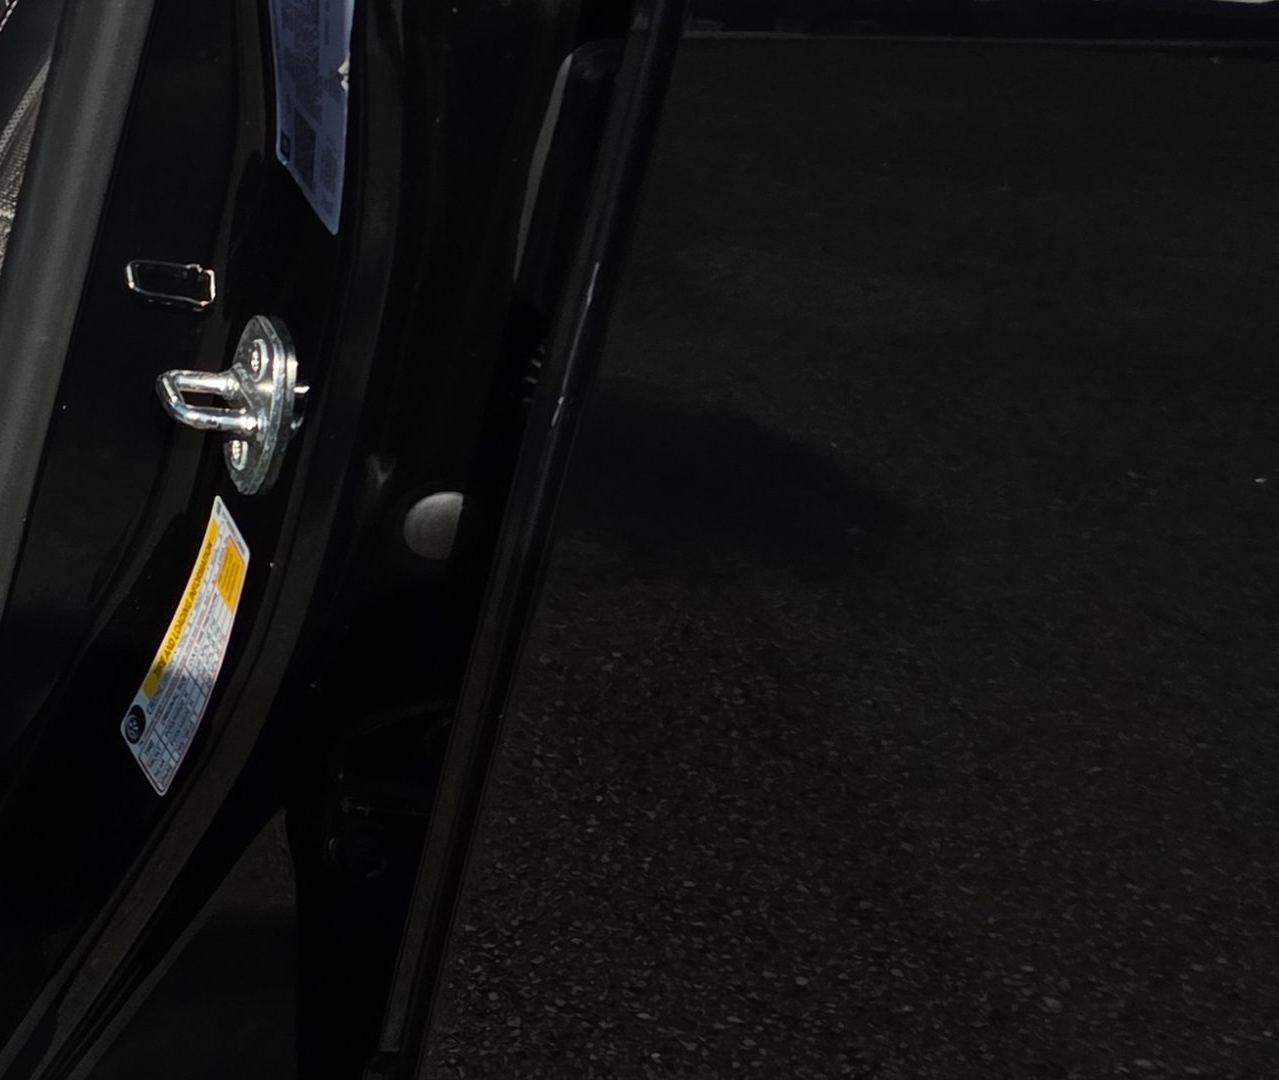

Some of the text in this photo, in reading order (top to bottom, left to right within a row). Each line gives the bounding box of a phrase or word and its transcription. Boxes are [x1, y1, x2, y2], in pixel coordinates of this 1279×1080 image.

[164, 638, 175, 660] AND
[173, 598, 194, 641] LOADING
[190, 542, 212, 599] INFORMATION
